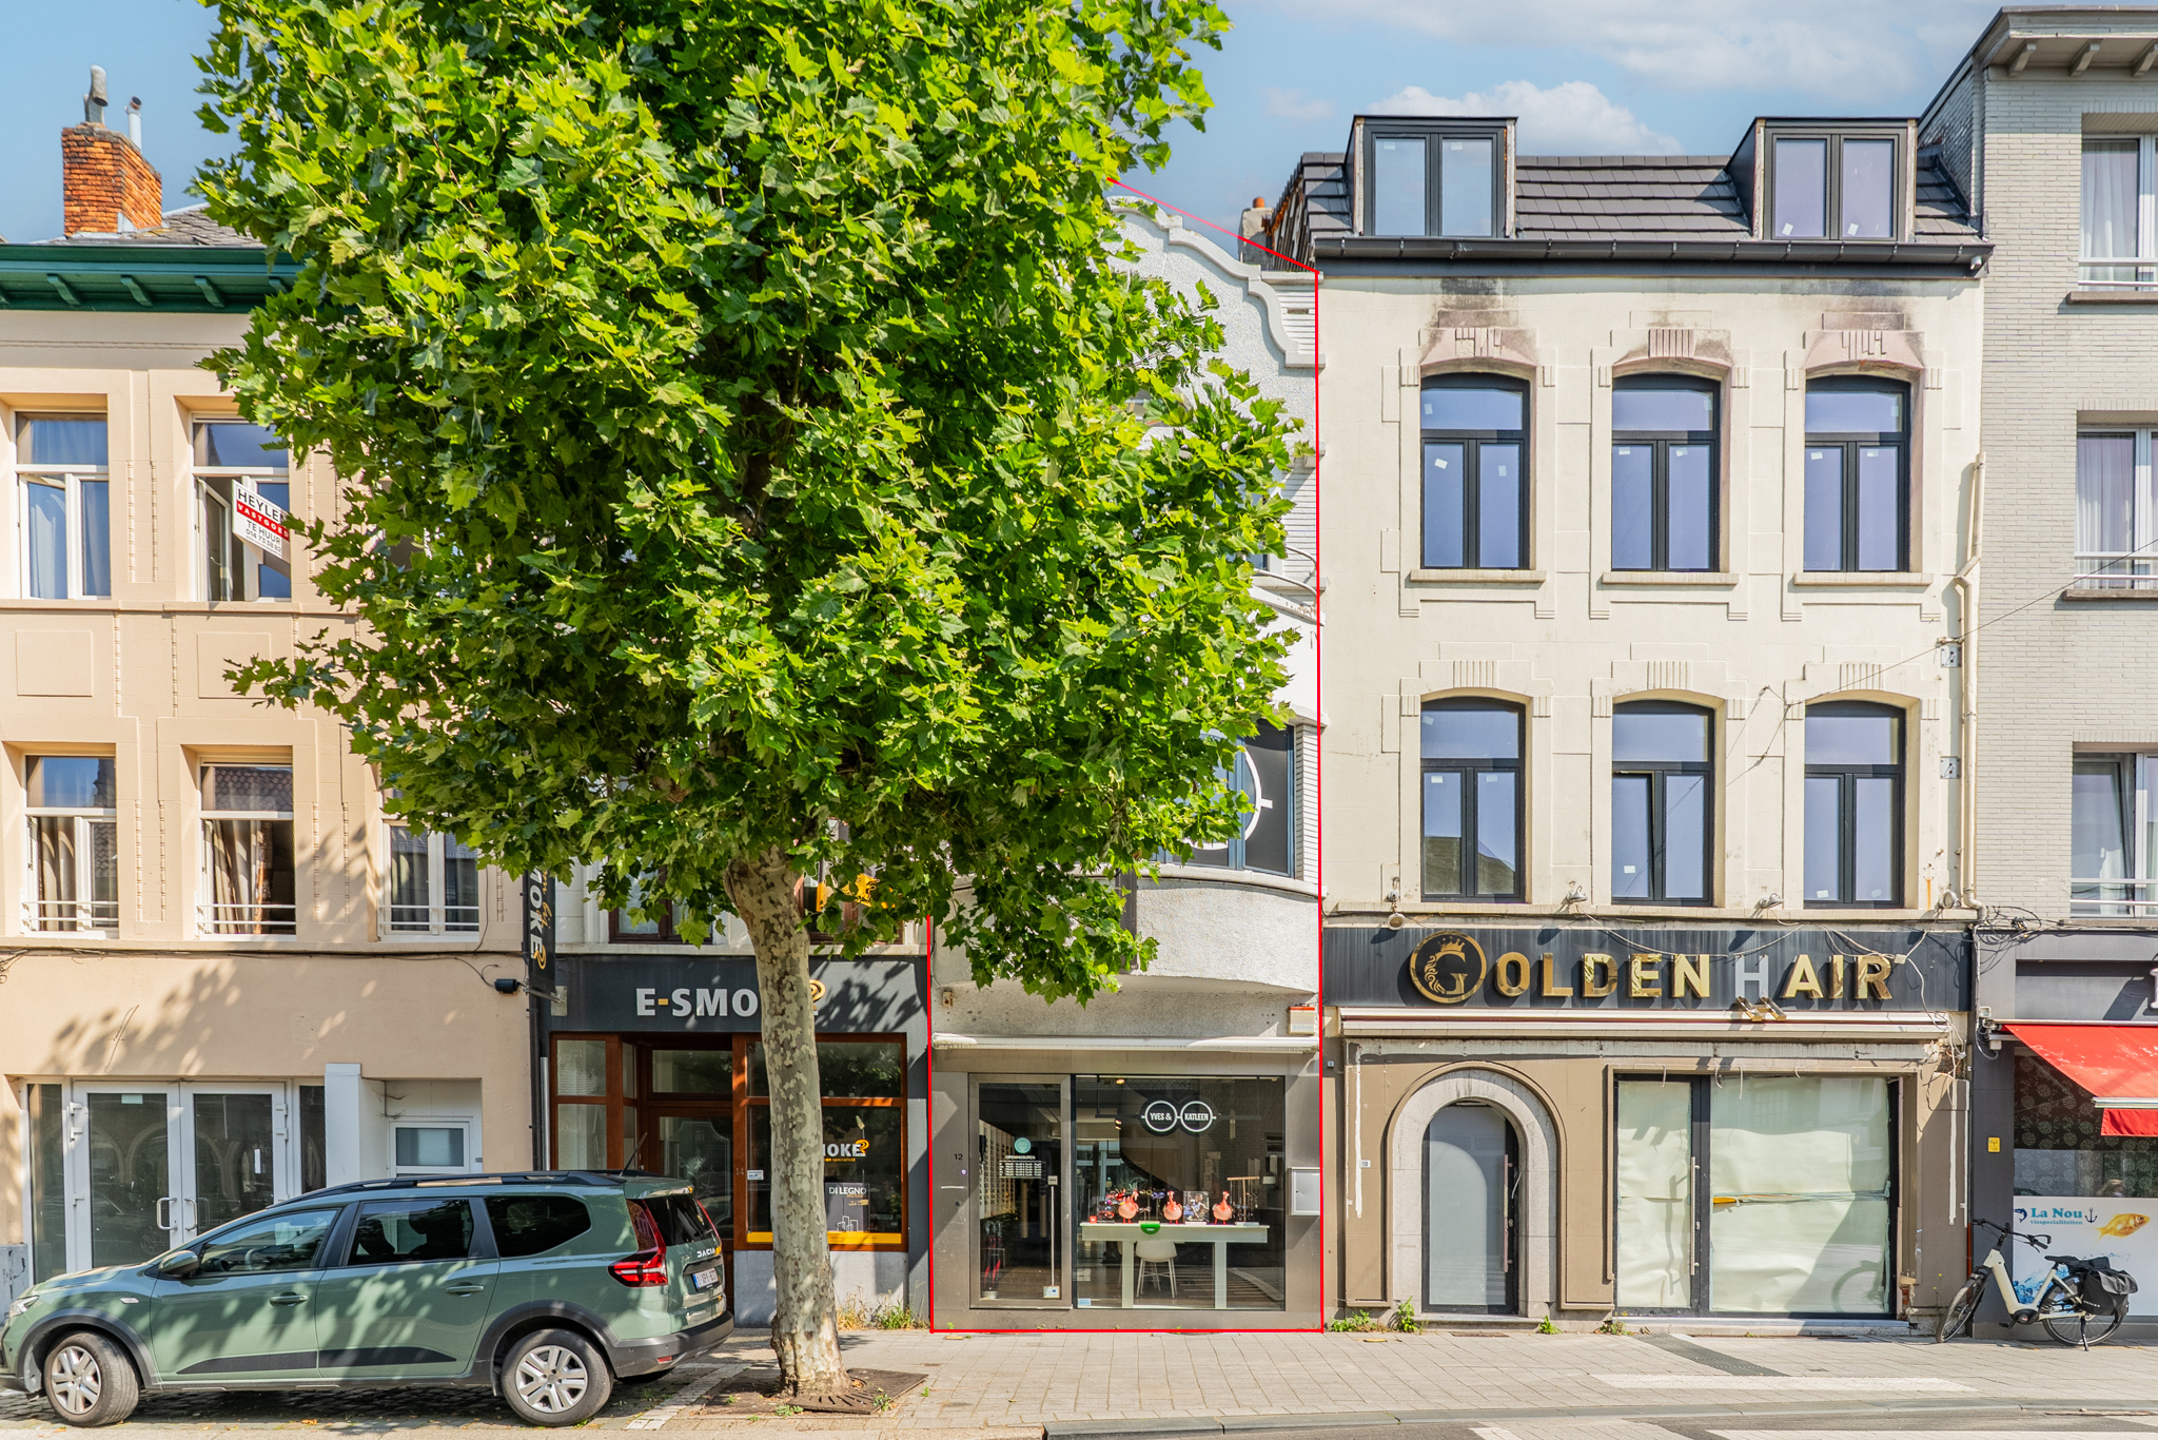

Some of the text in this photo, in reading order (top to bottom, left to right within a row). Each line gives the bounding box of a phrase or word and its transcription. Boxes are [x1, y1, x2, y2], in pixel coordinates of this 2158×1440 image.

[237, 503, 289, 538] VASTGOED
[247, 520, 281, 545] TE HUUR
[1734, 954, 1892, 999] HAIR
[636, 988, 759, 1017] E-SMO
[1150, 1113, 1209, 1121] YVES & KATLEEN
[839, 1187, 867, 1195] LEGNO
[2031, 1207, 2083, 1218] La Nou
[697, 1247, 715, 1258] DACIA
